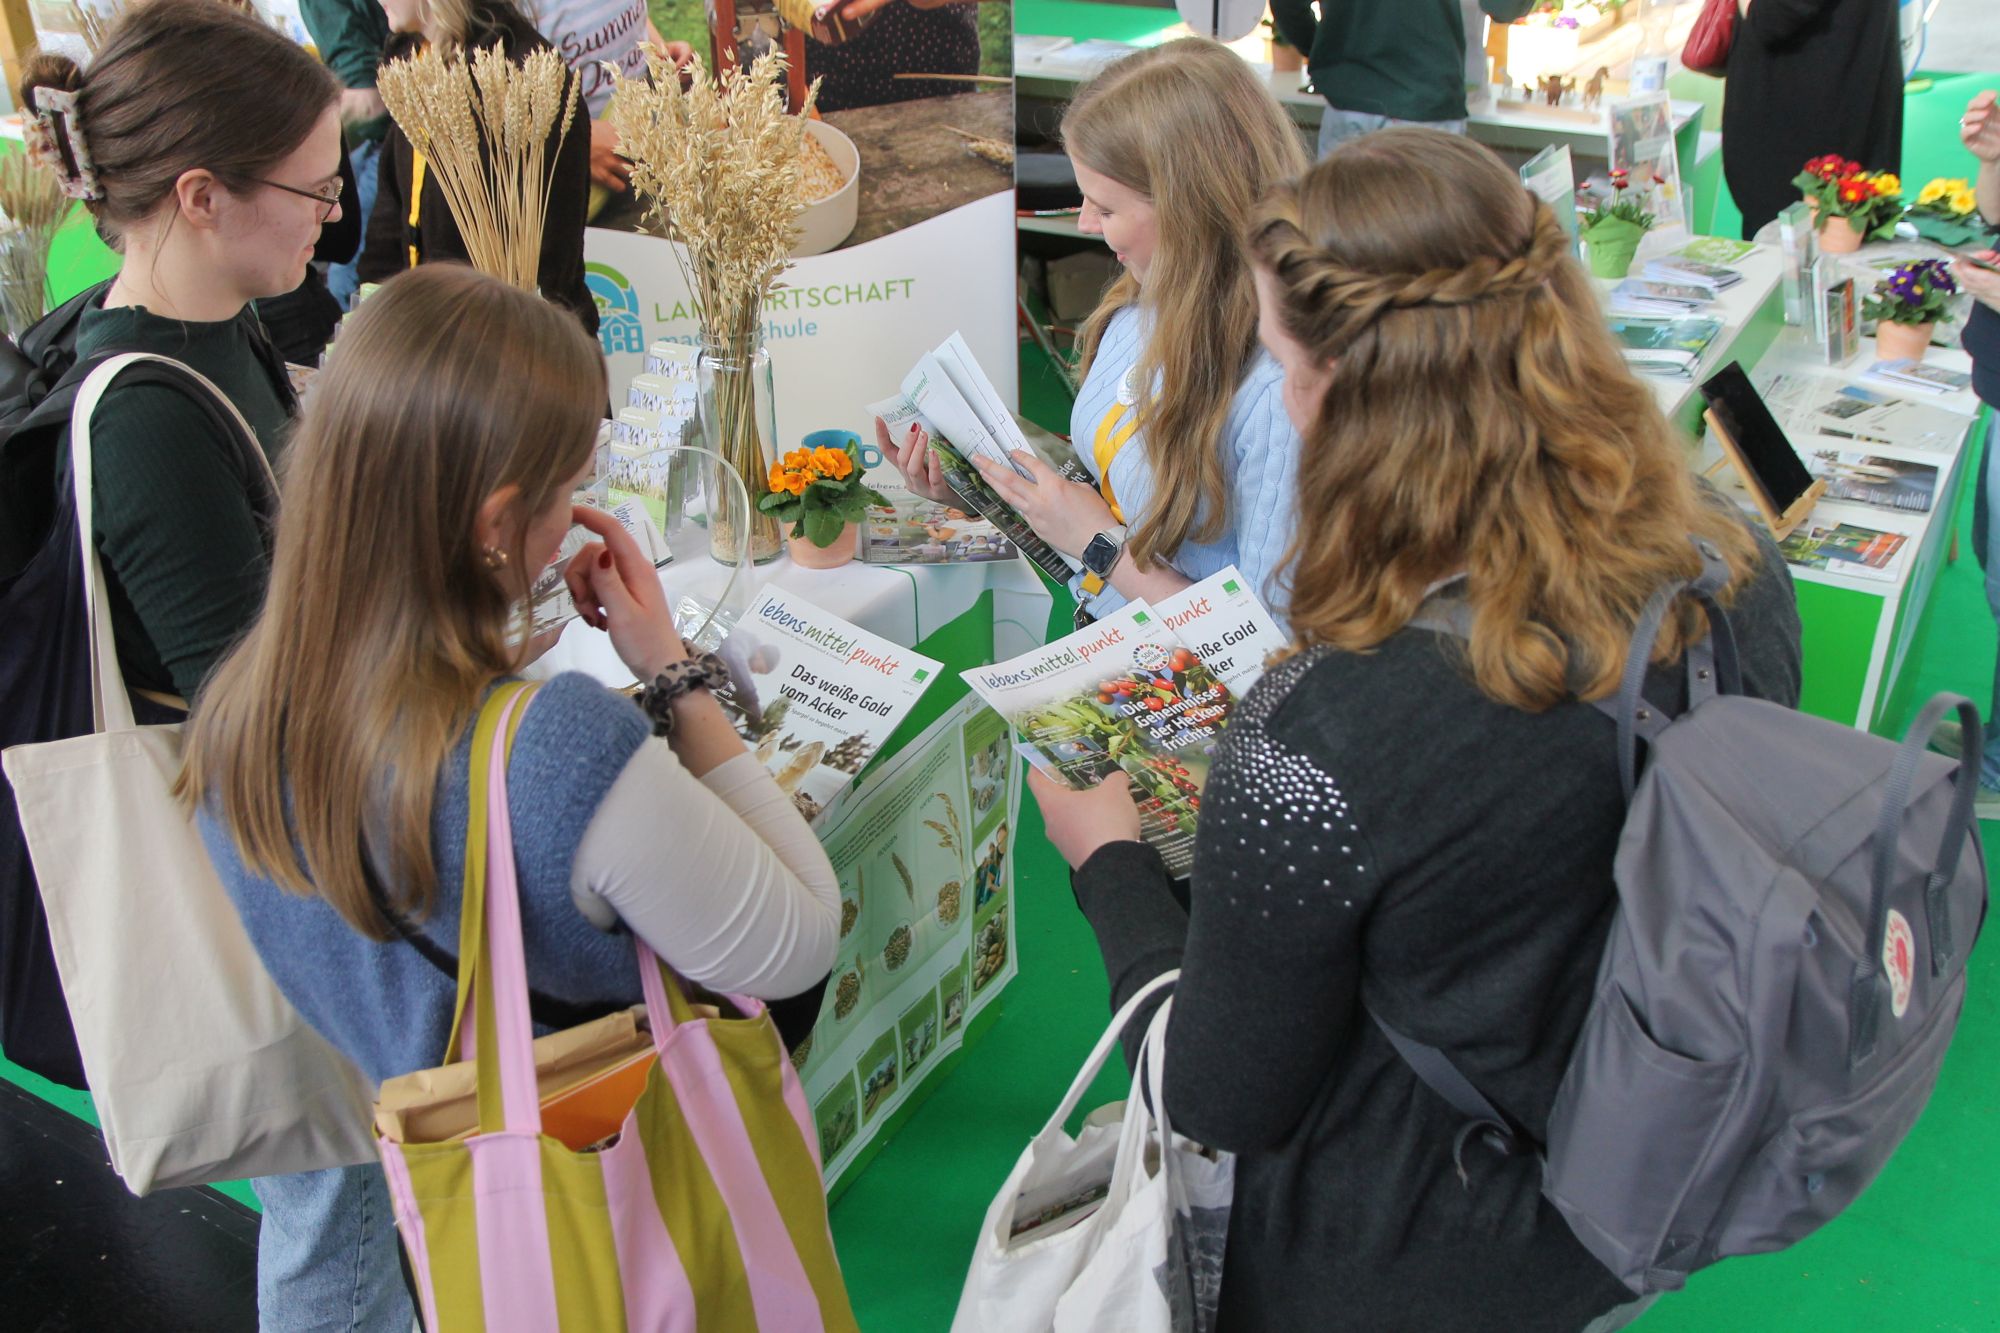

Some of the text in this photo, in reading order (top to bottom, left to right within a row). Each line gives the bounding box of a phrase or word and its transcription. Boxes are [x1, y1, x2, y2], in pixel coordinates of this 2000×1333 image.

[1193, 619, 1258, 665] eiße Gold
[1208, 654, 1236, 677] ker
[779, 682, 810, 705] vom
[808, 696, 849, 721] Acker
[791, 663, 894, 718] Das weiße Gold
[1120, 700, 1149, 716] Die
[1149, 703, 1227, 740] der Hecken-
[1161, 725, 1216, 752] früchte
